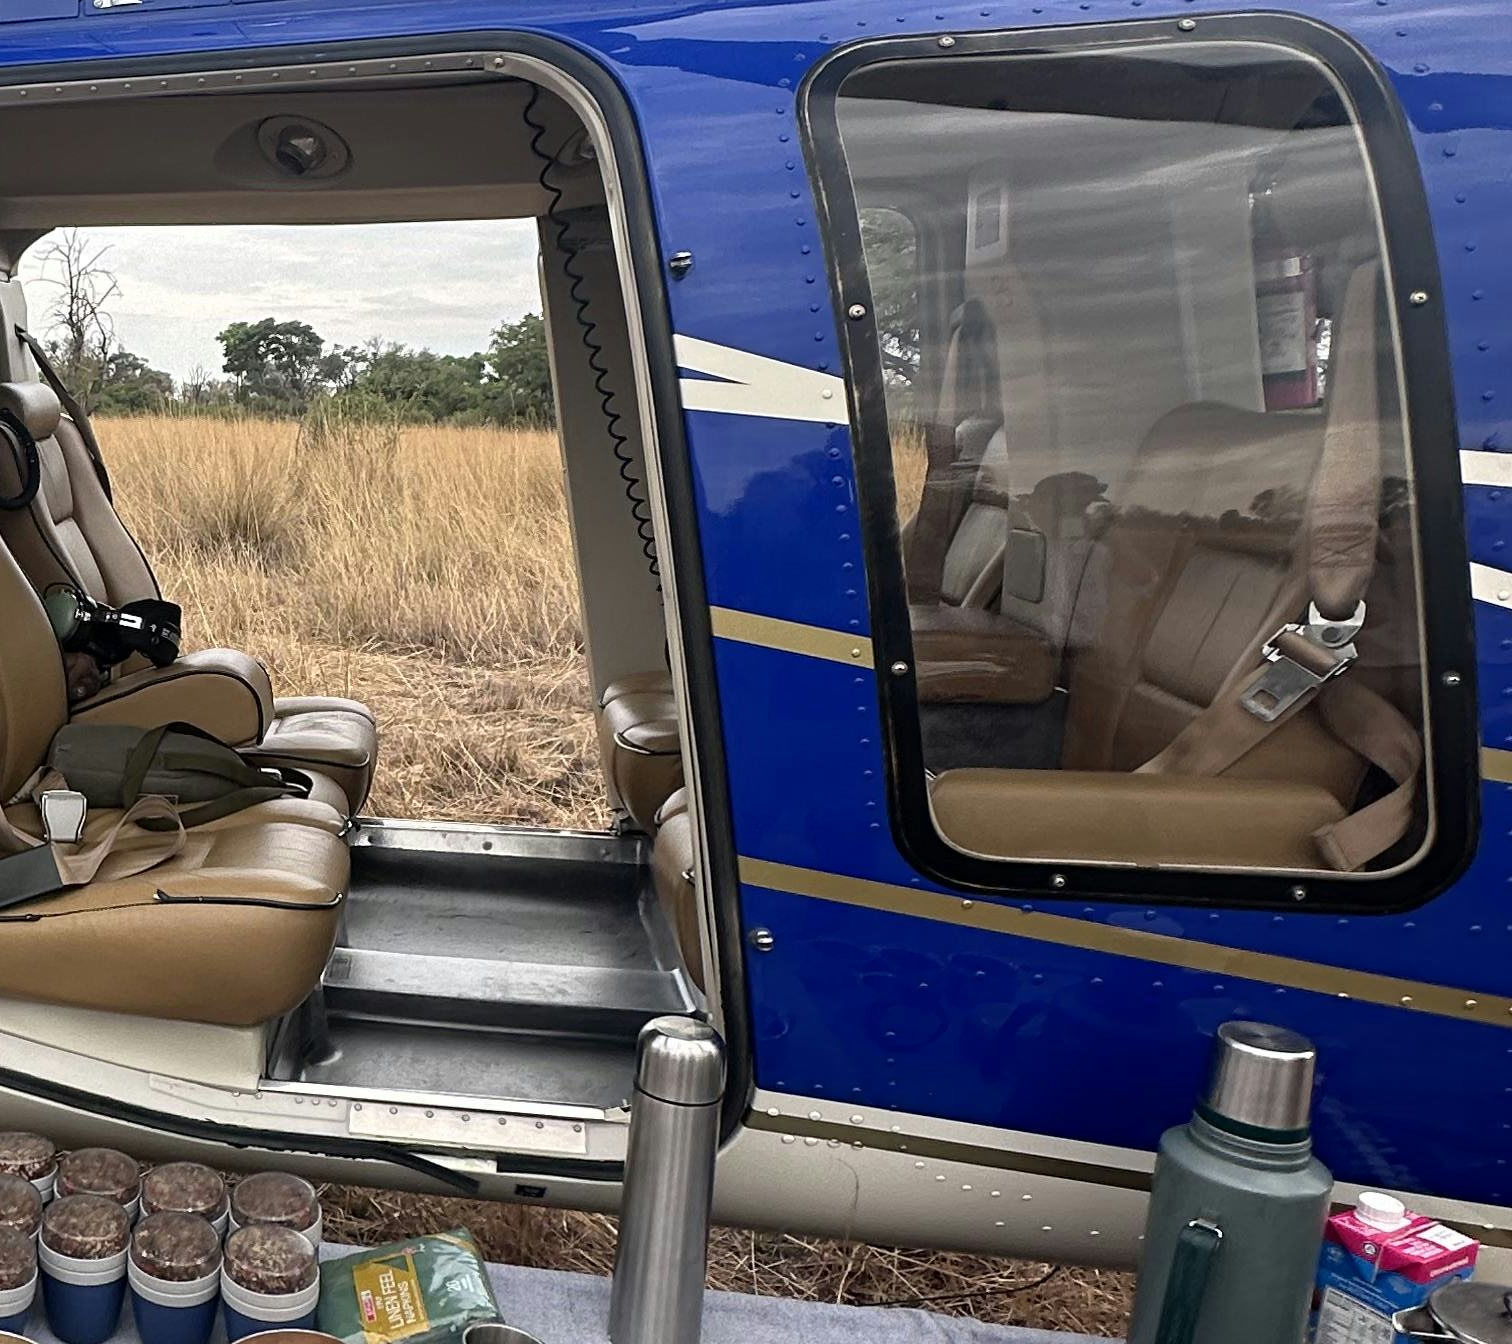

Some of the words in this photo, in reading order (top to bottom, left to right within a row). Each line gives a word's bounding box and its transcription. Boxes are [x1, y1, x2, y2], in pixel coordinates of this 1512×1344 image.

[379, 1268, 396, 1296] FEEL
[384, 1295, 405, 1330] LINEN
[397, 1280, 417, 1325] NAPKINS
